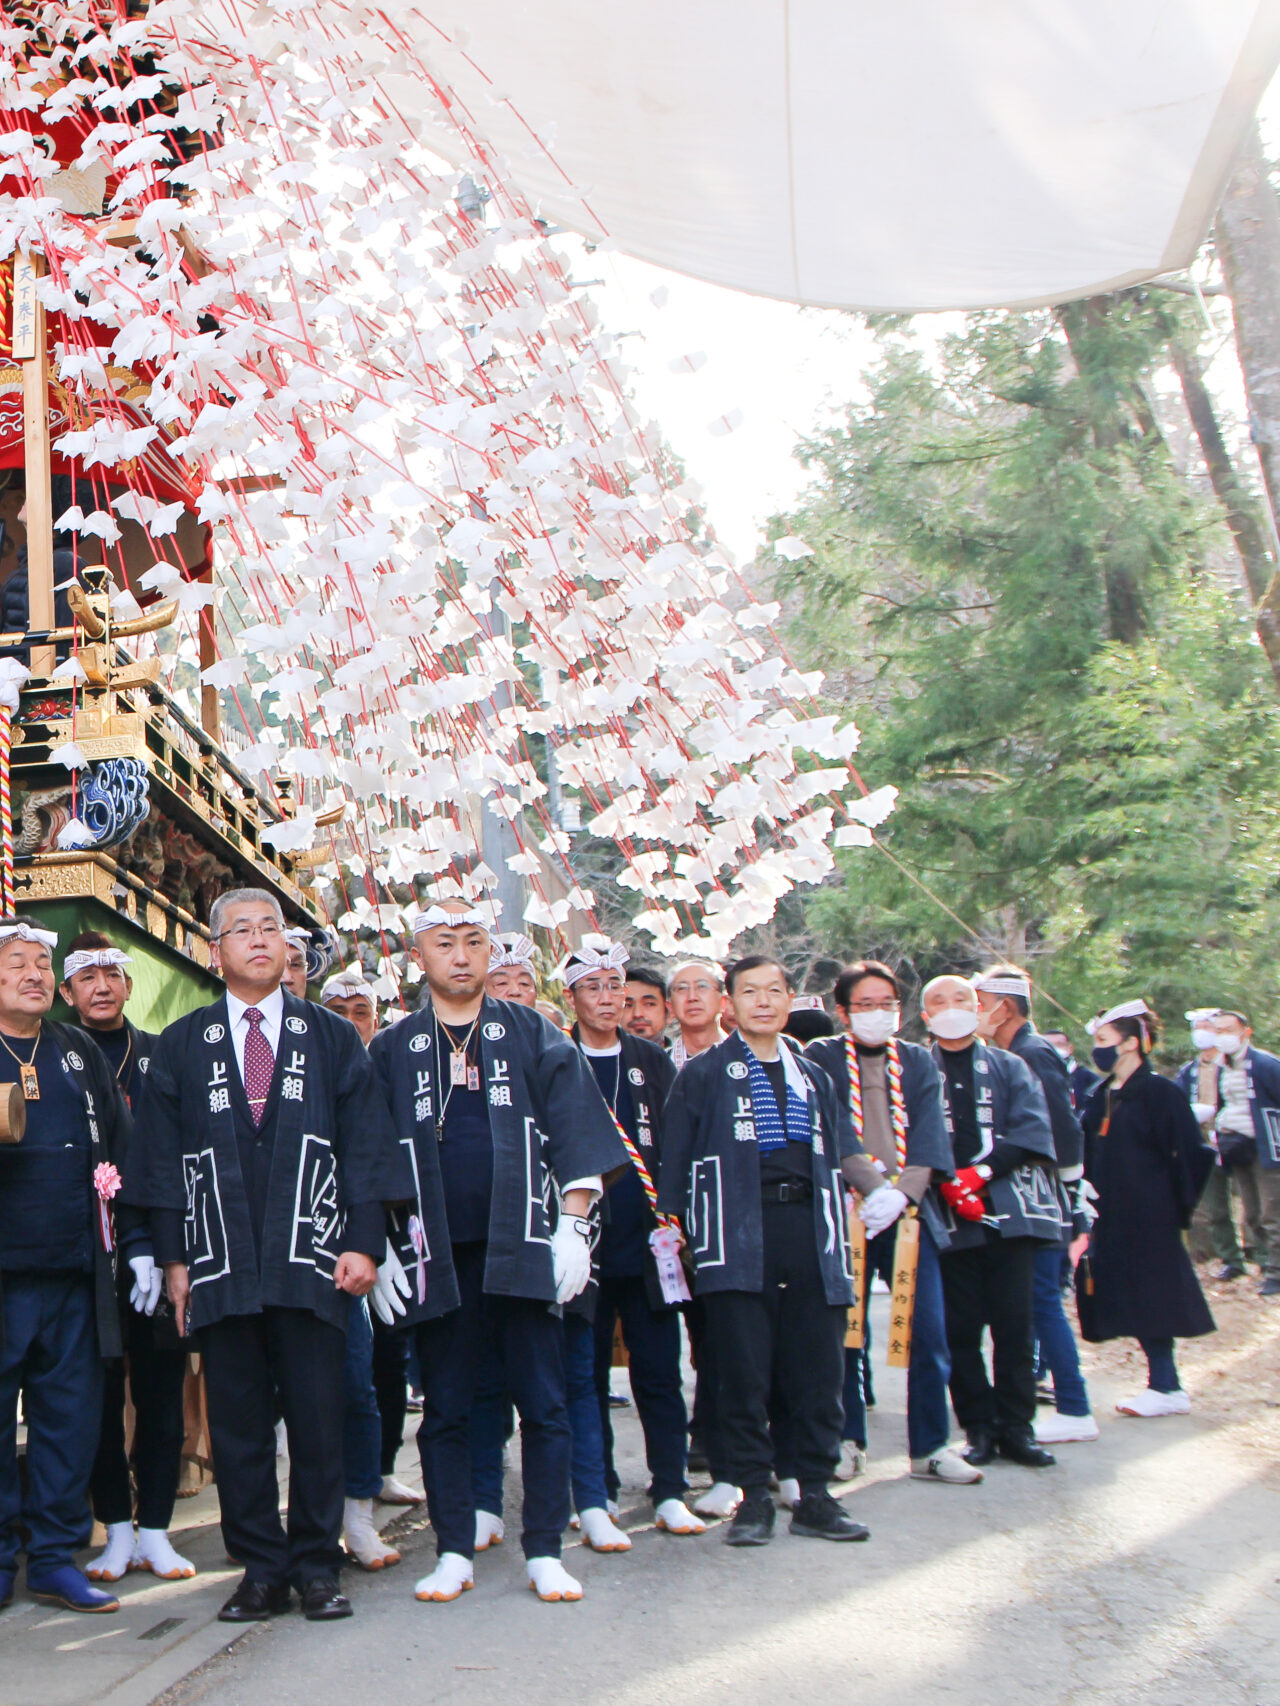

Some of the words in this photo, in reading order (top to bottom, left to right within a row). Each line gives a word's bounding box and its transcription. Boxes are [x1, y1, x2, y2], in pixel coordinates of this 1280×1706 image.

[16, 265, 35, 347] 天下泰平
[207, 1061, 231, 1113] 上組
[281, 1050, 304, 1102] 上組
[414, 1071, 433, 1122] 上組
[488, 1059, 512, 1106] 上組
[86, 1090, 100, 1143] 上組
[638, 1103, 652, 1147] 上組
[733, 1096, 757, 1141] 上組
[892, 1269, 910, 1354] 家内安全
